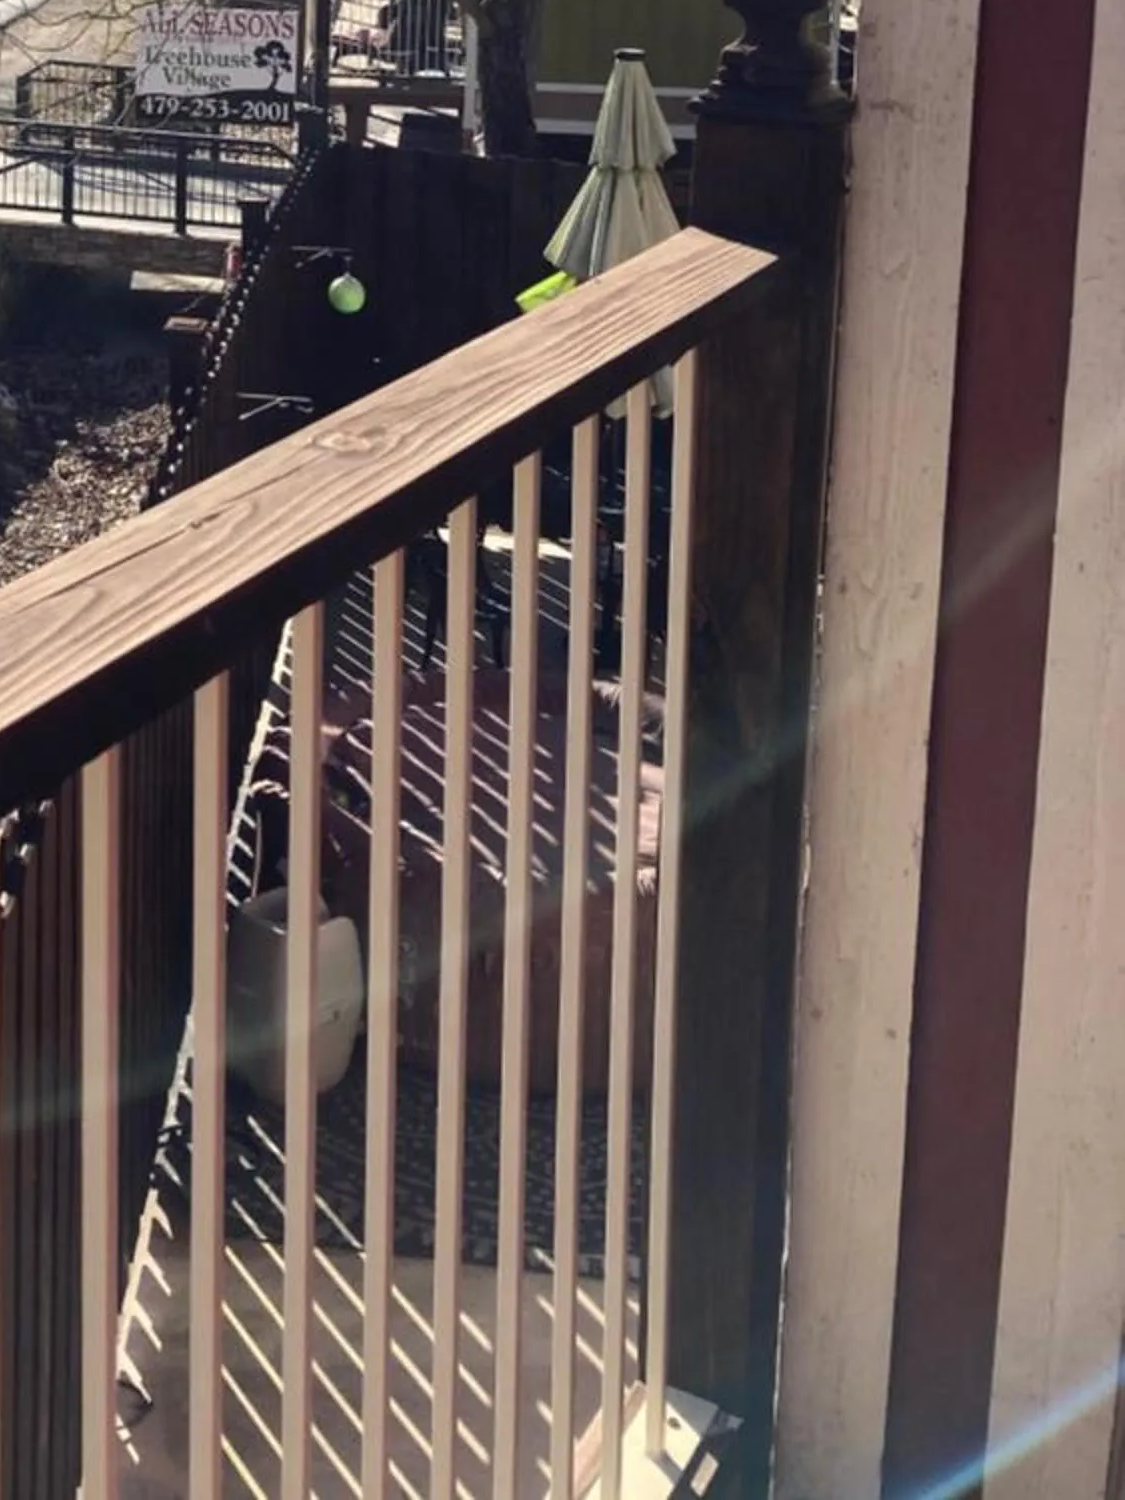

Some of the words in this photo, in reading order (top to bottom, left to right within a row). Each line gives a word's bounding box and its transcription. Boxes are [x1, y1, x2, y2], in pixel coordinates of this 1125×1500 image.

[190, 12, 294, 37] SEASONS
[145, 46, 253, 68] Treehouse
[163, 66, 233, 88] Village
[141, 95, 291, 123] 479-253-2001
